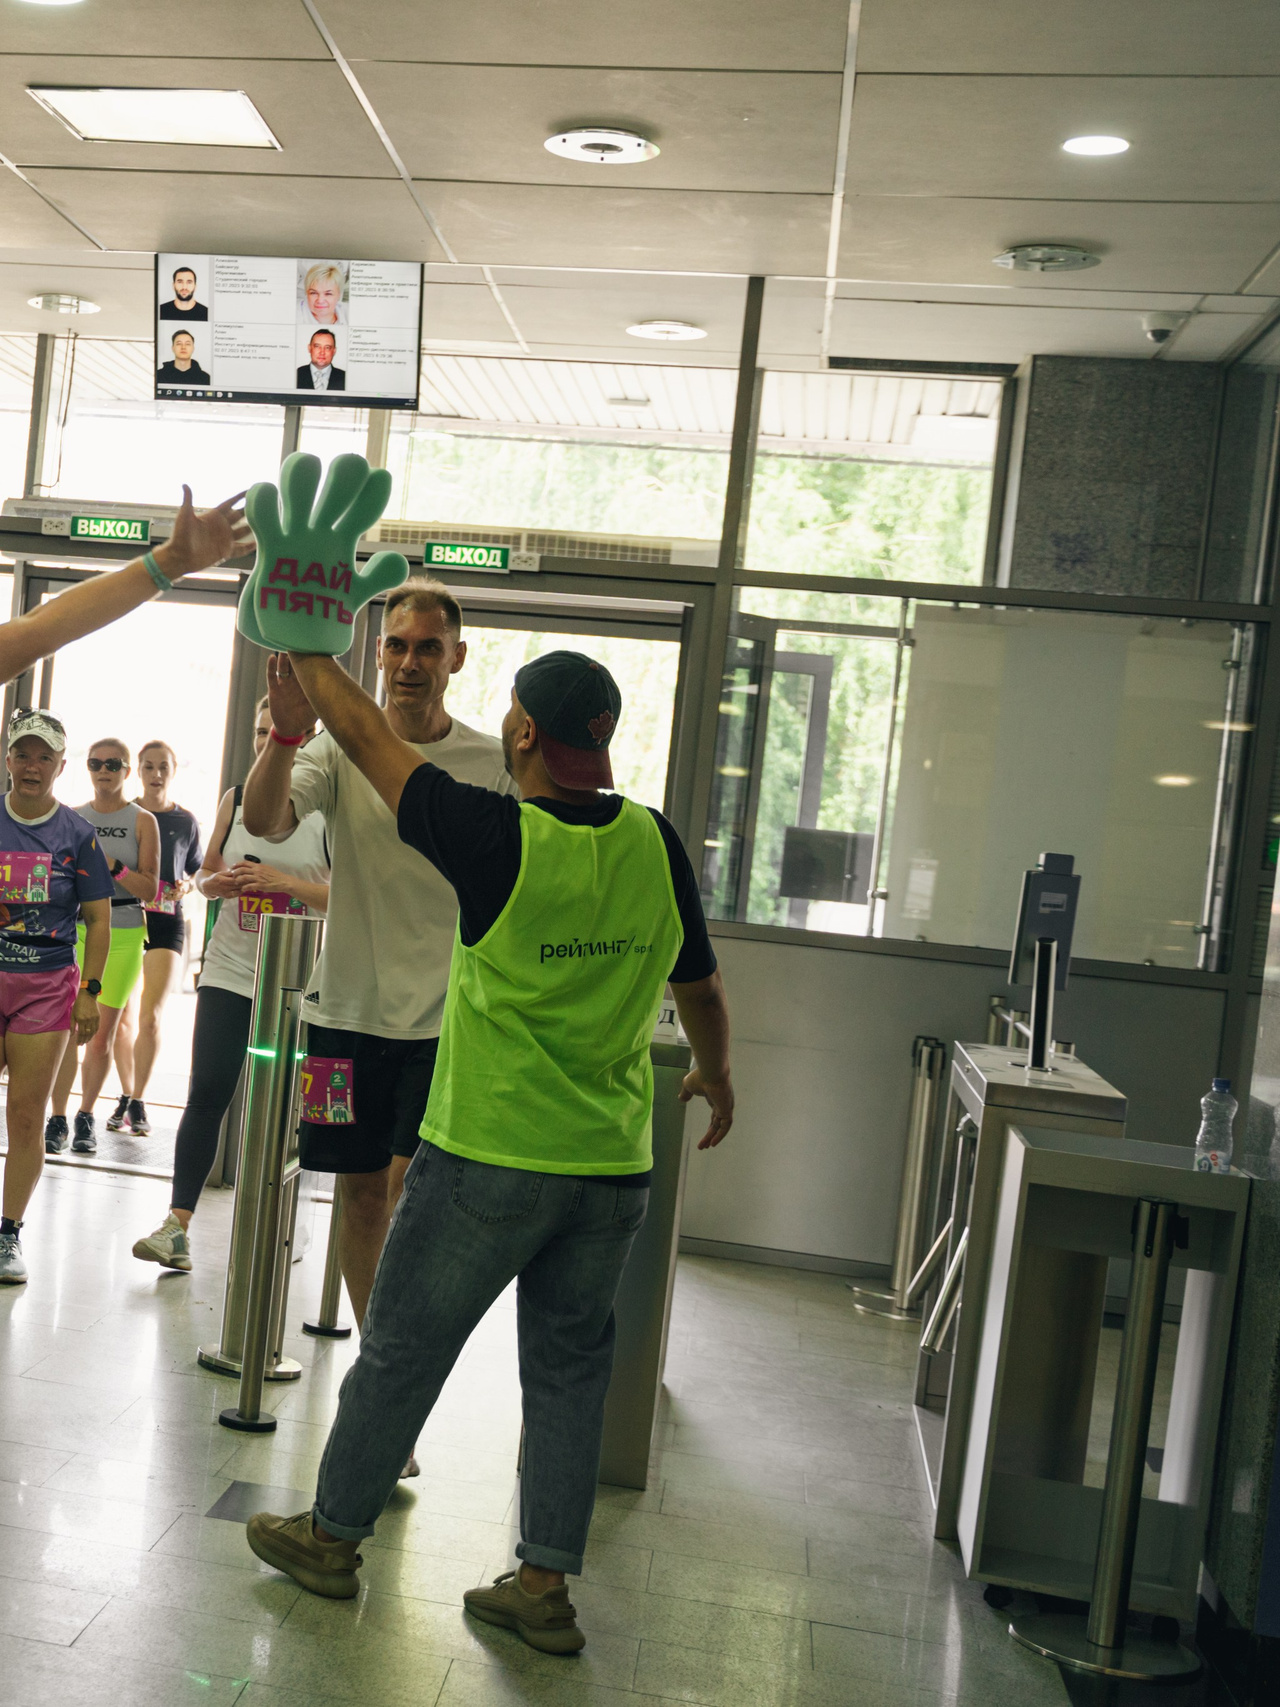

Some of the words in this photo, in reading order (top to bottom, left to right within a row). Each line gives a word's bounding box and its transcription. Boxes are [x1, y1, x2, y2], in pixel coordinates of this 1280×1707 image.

[77, 518, 143, 541] ВЫХОД
[431, 544, 502, 568] ВЫХОД
[268, 557, 353, 594] ДАЙ
[259, 586, 354, 626] ПЯТЬ
[239, 896, 274, 914] 176
[333, 1074, 342, 1083] 2
